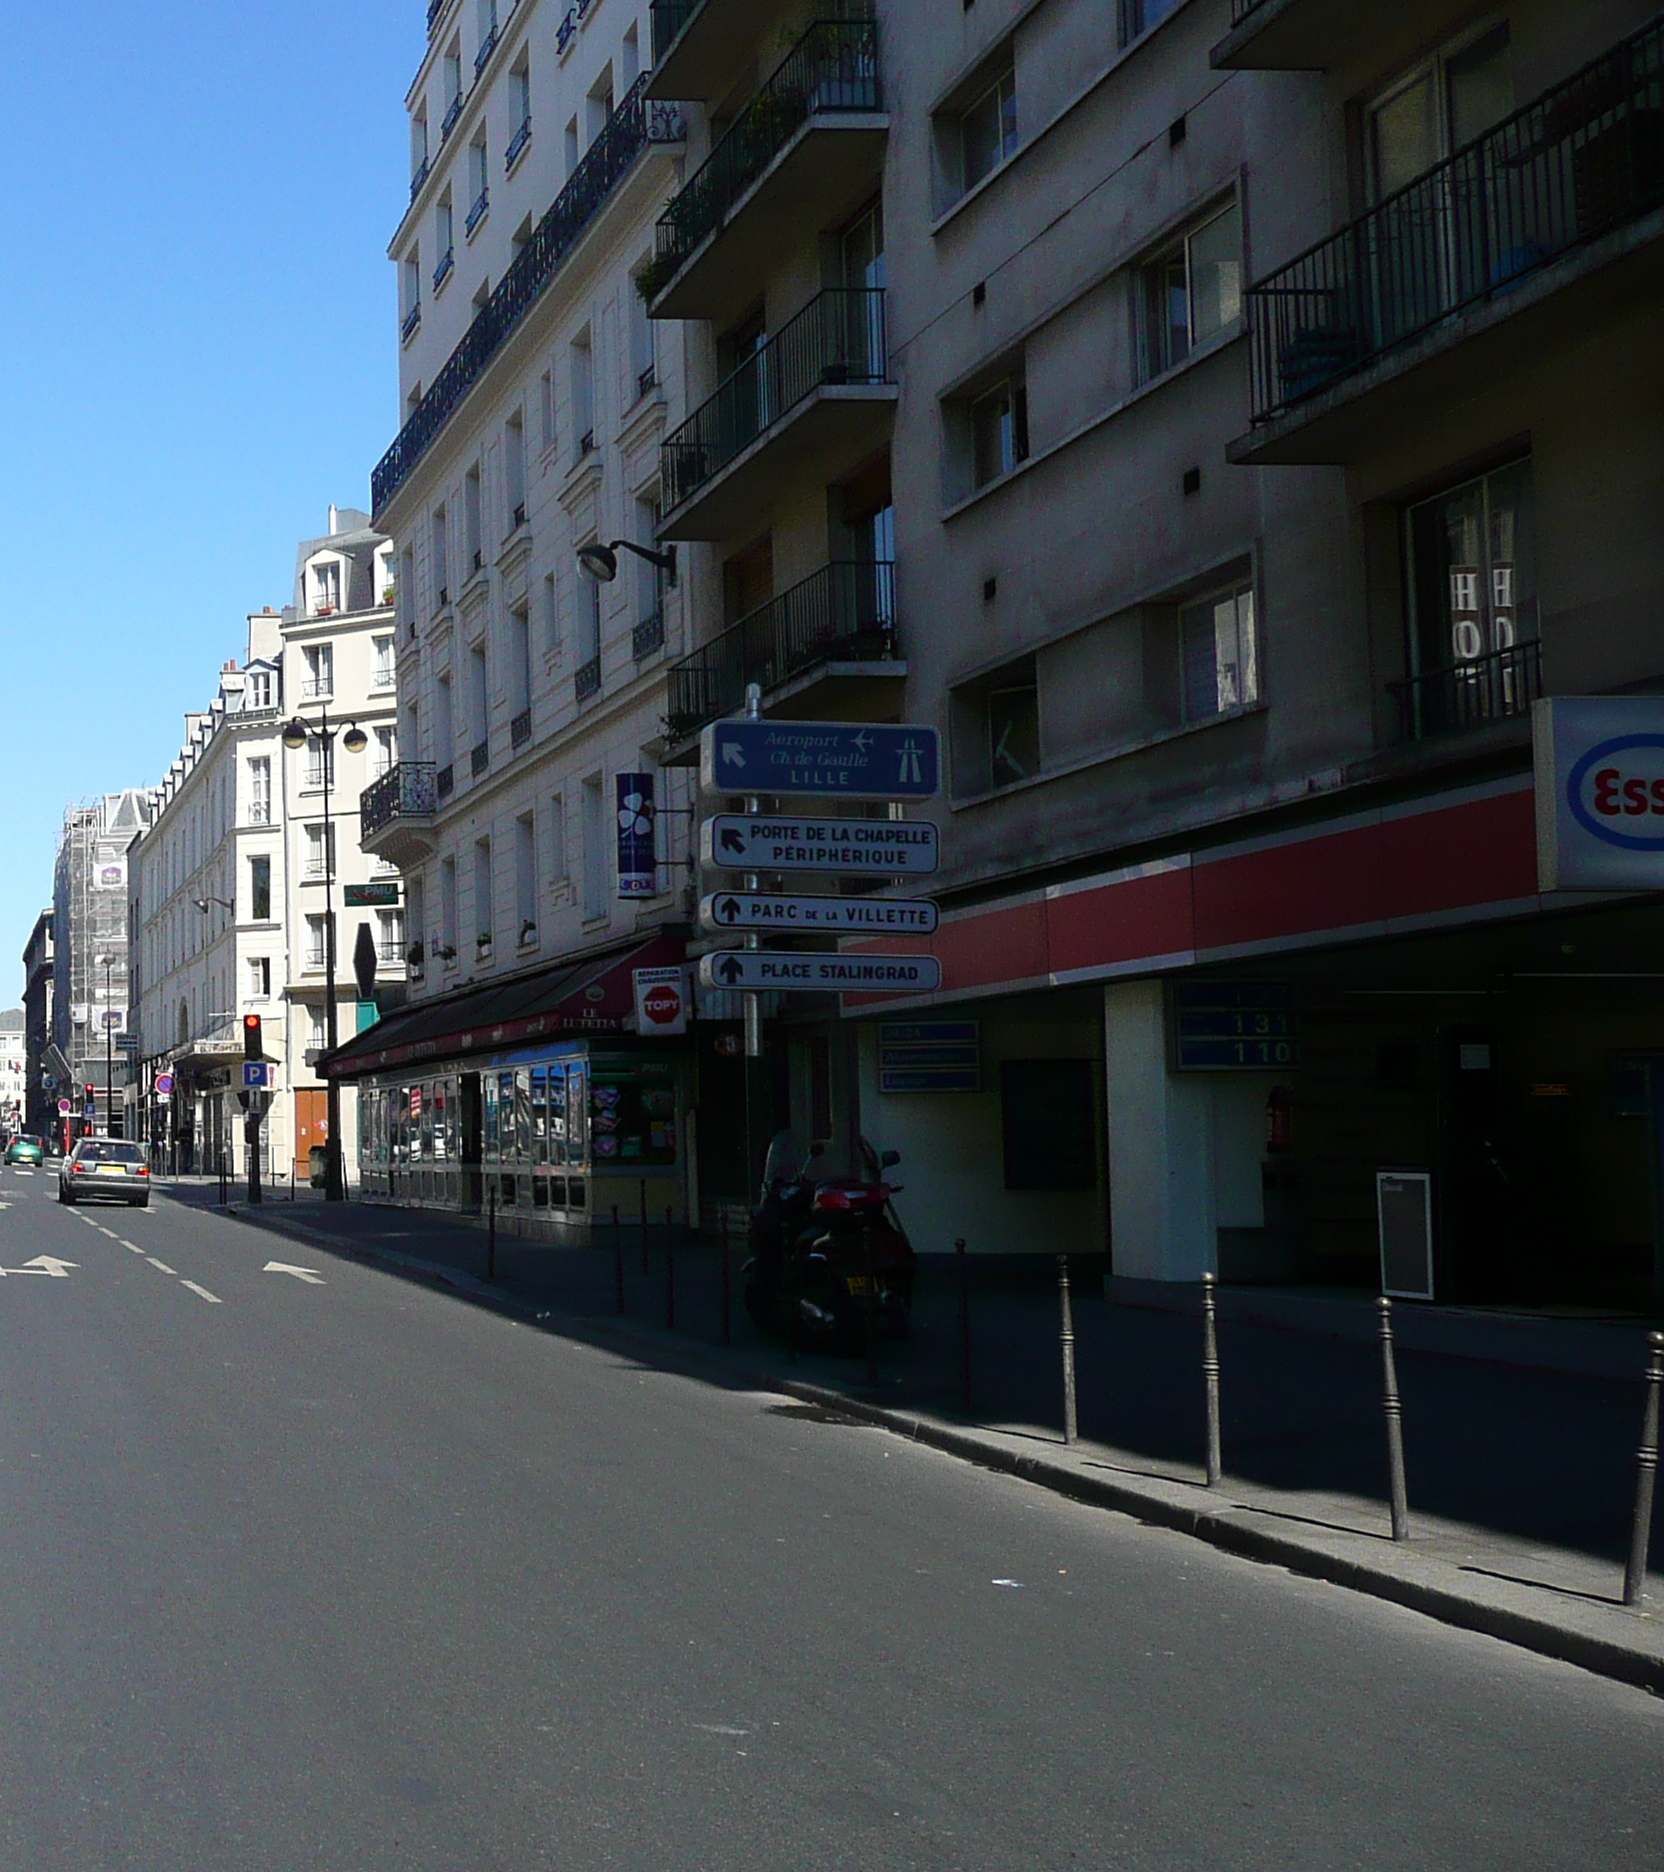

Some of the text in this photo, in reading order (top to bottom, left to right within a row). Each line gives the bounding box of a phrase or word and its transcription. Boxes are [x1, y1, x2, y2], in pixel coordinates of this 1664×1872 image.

[817, 751, 869, 768] Gaulle
[791, 769, 850, 785] LILLE
[751, 825, 931, 844] PORTE DE LA CHAPELLE
[773, 844, 907, 864] PÉRIPHÉRIQUE
[364, 884, 394, 895] PMU
[751, 903, 928, 924] PARC DE LA VILLETTE
[638, 969, 680, 978] REPARATION
[761, 963, 919, 981] PLACE STALINGRAD
[583, 1008, 599, 1018] LE
[644, 1001, 679, 1012] TOPY
[250, 1066, 260, 1083] P
